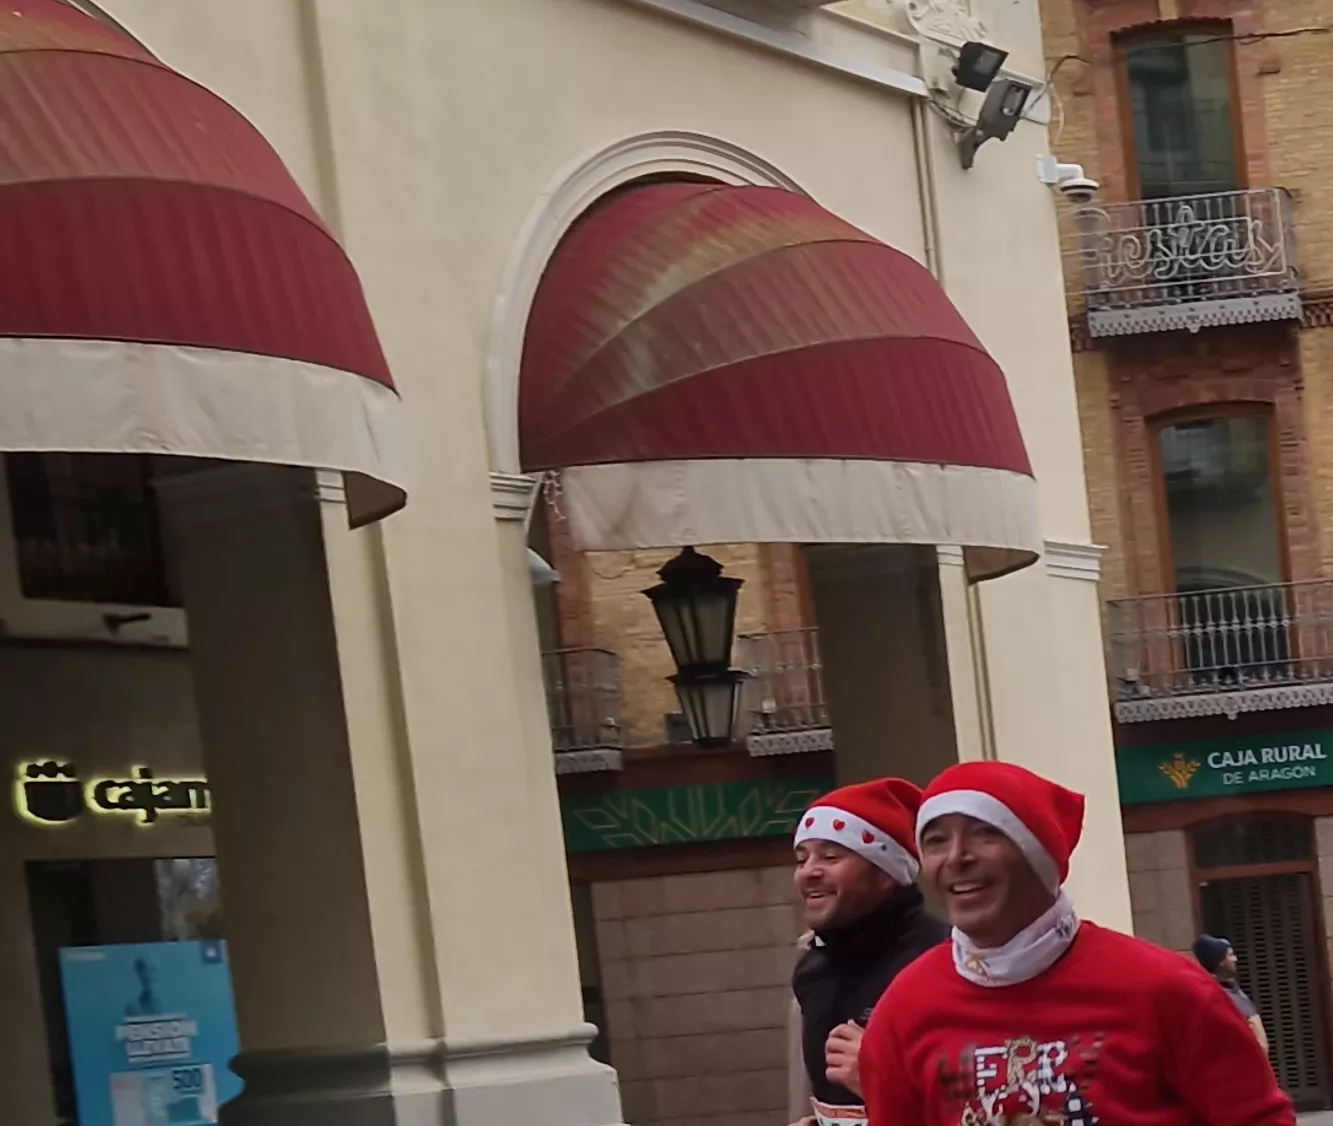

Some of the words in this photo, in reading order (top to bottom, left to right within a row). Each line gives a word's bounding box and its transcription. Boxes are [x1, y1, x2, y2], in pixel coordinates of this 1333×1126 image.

[1207, 749, 1258, 769] CAJA
[1260, 743, 1328, 765] RURAL
[1222, 771, 1244, 785] DE
[172, 1067, 201, 1091] 500
